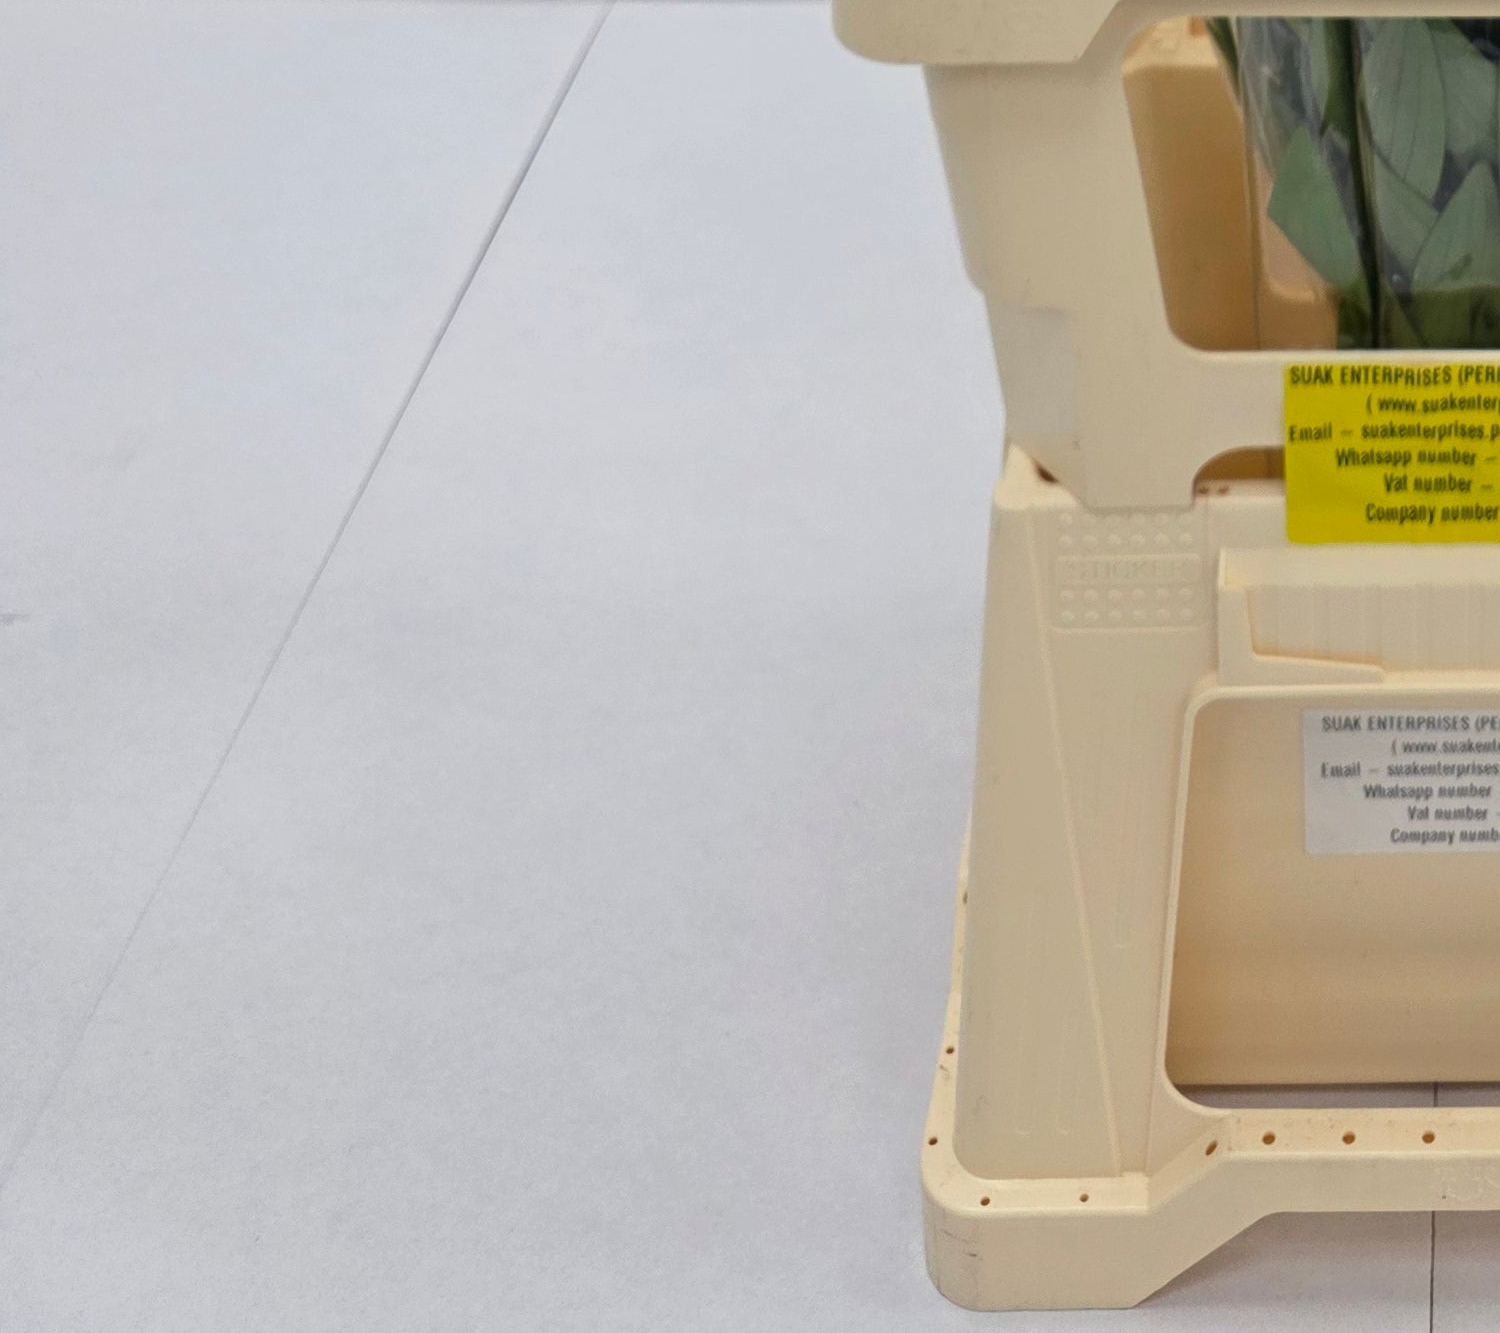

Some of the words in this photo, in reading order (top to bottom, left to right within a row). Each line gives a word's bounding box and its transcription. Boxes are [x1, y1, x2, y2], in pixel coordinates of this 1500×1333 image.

[1290, 367, 1334, 385] SUAK
[1340, 366, 1452, 385] ENTERPRISES
[1289, 424, 1333, 442] Email
[1335, 448, 1412, 467] Whatsapp
[1417, 450, 1476, 465] number
[1384, 474, 1408, 492] Vat
[1414, 475, 1471, 492] number
[1366, 503, 1435, 524] Company
[1440, 505, 1499, 521] number
